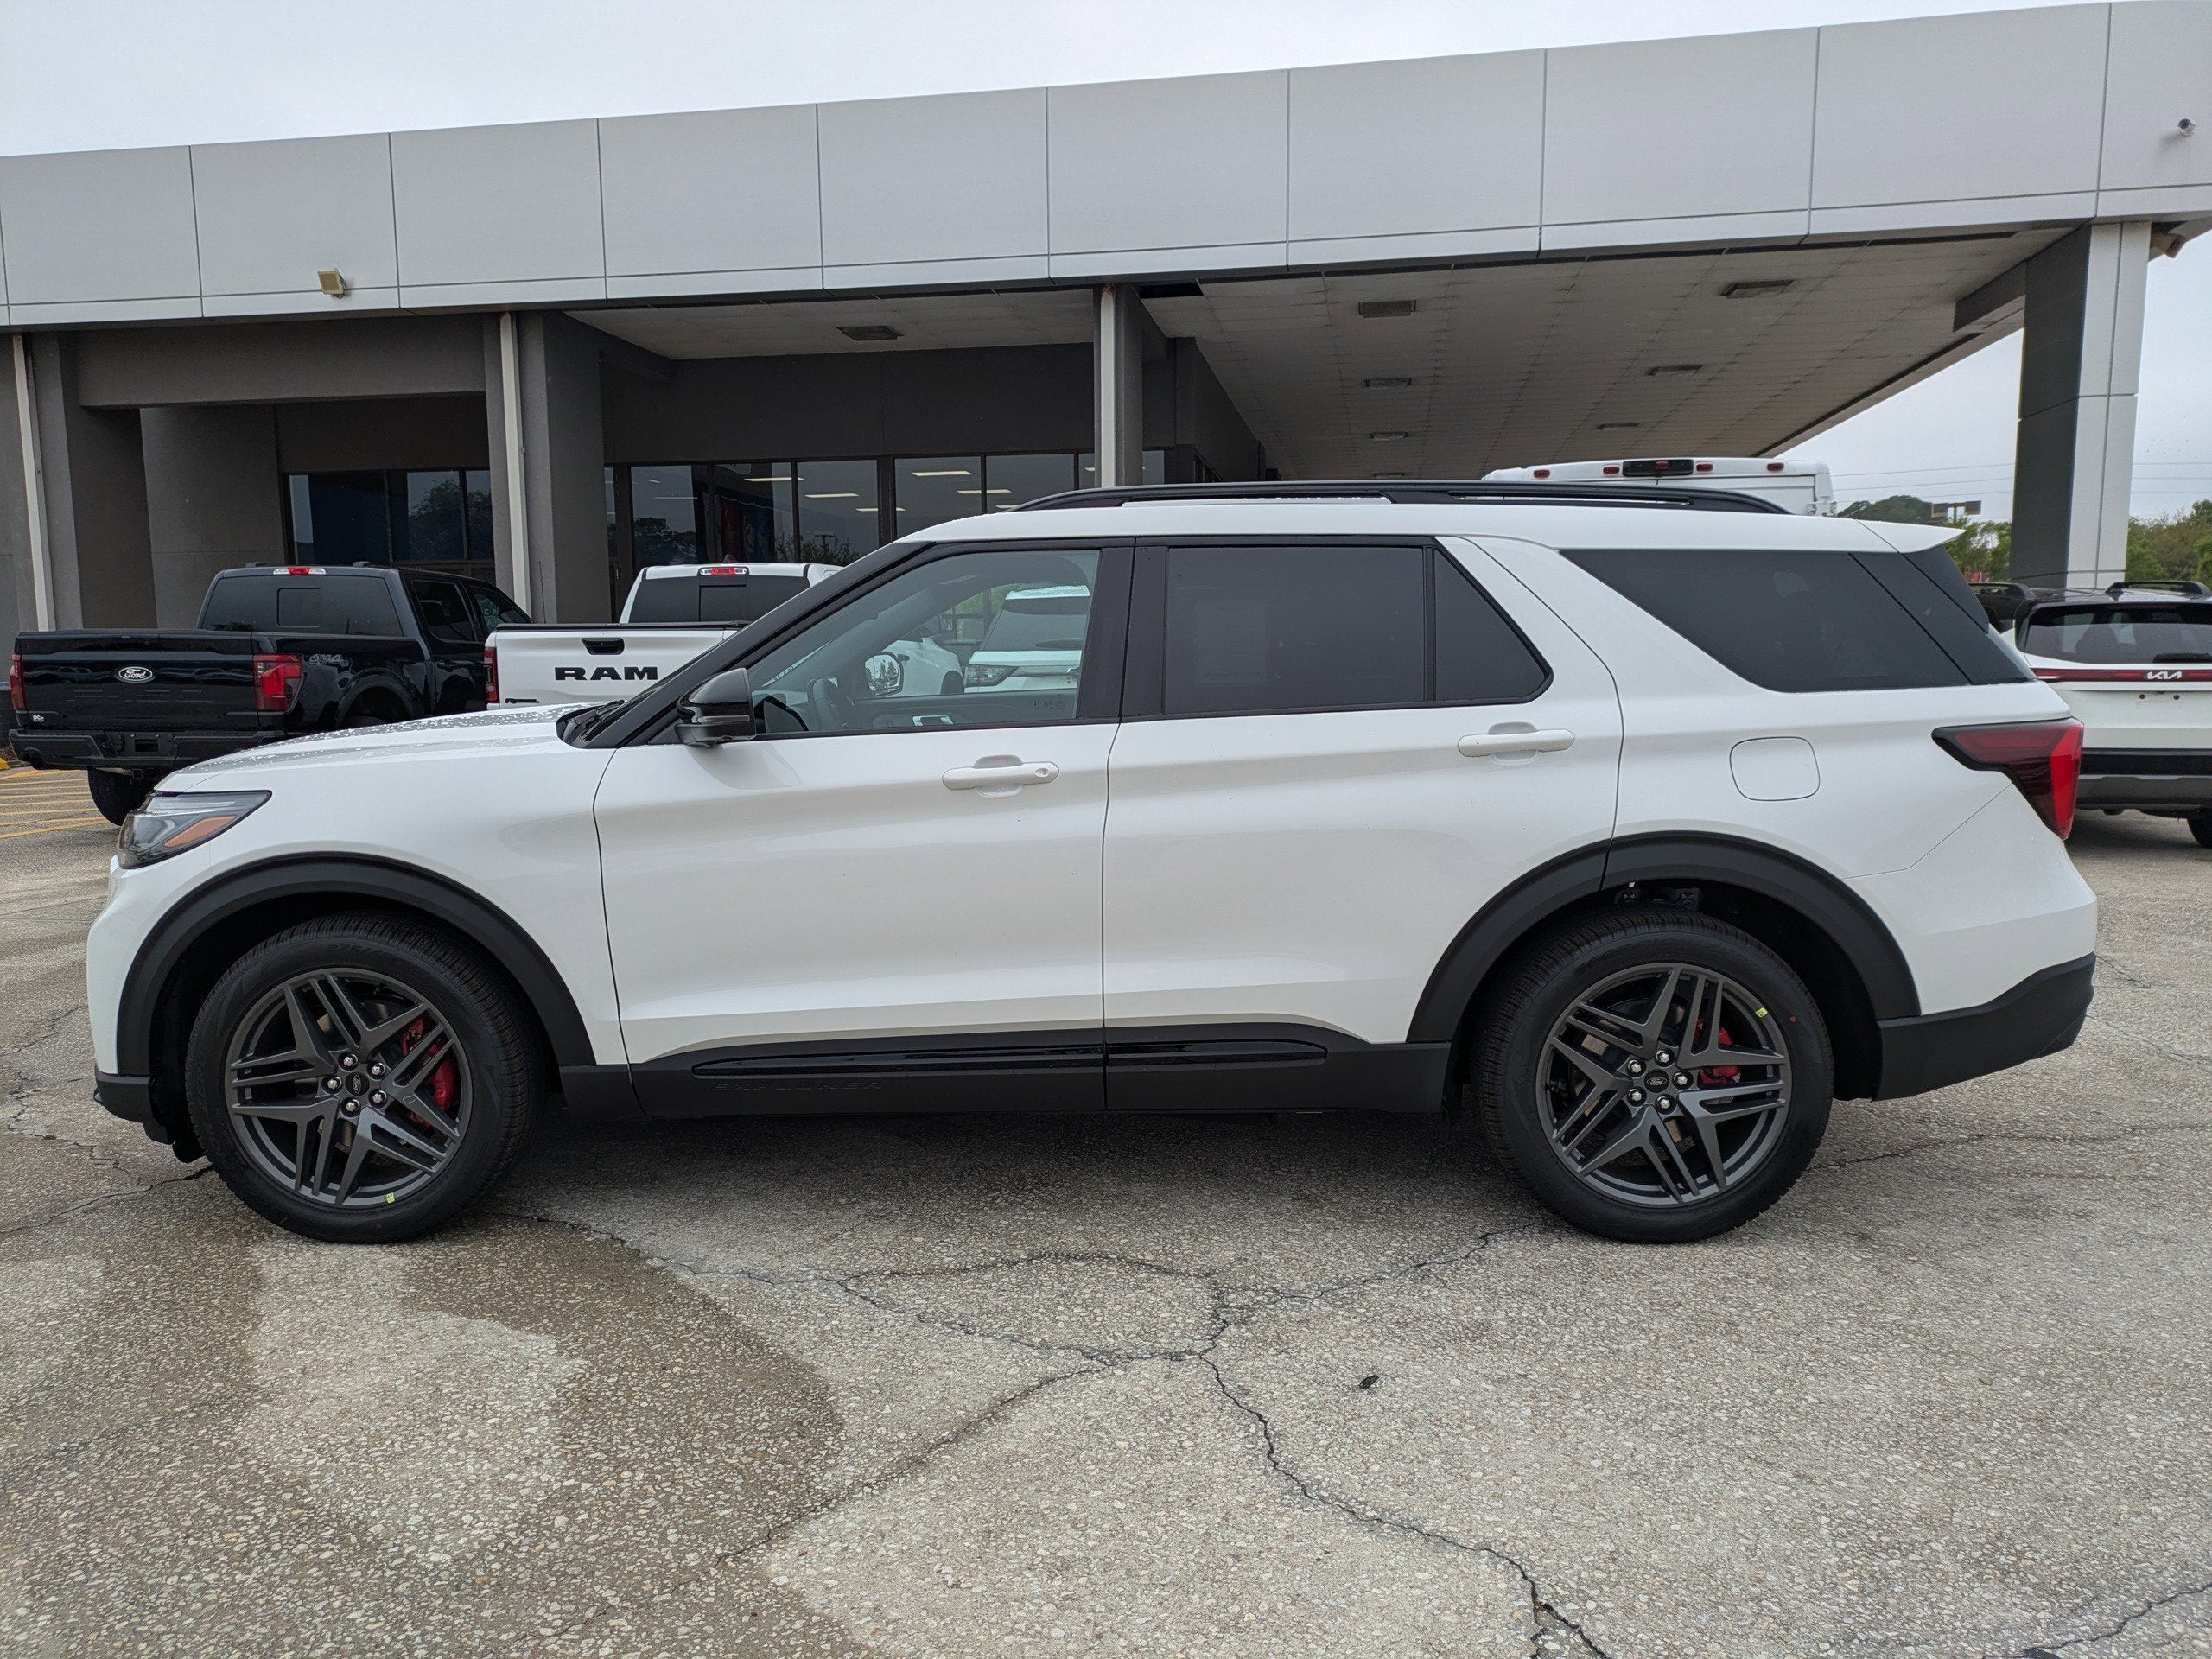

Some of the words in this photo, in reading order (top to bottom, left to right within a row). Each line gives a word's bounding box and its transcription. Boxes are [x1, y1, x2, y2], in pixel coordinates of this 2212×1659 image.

[123, 668, 148, 679] Ford
[554, 666, 658, 681] RAM
[2147, 671, 2183, 680] KIA
[709, 1082, 883, 1092] EXPLORER
